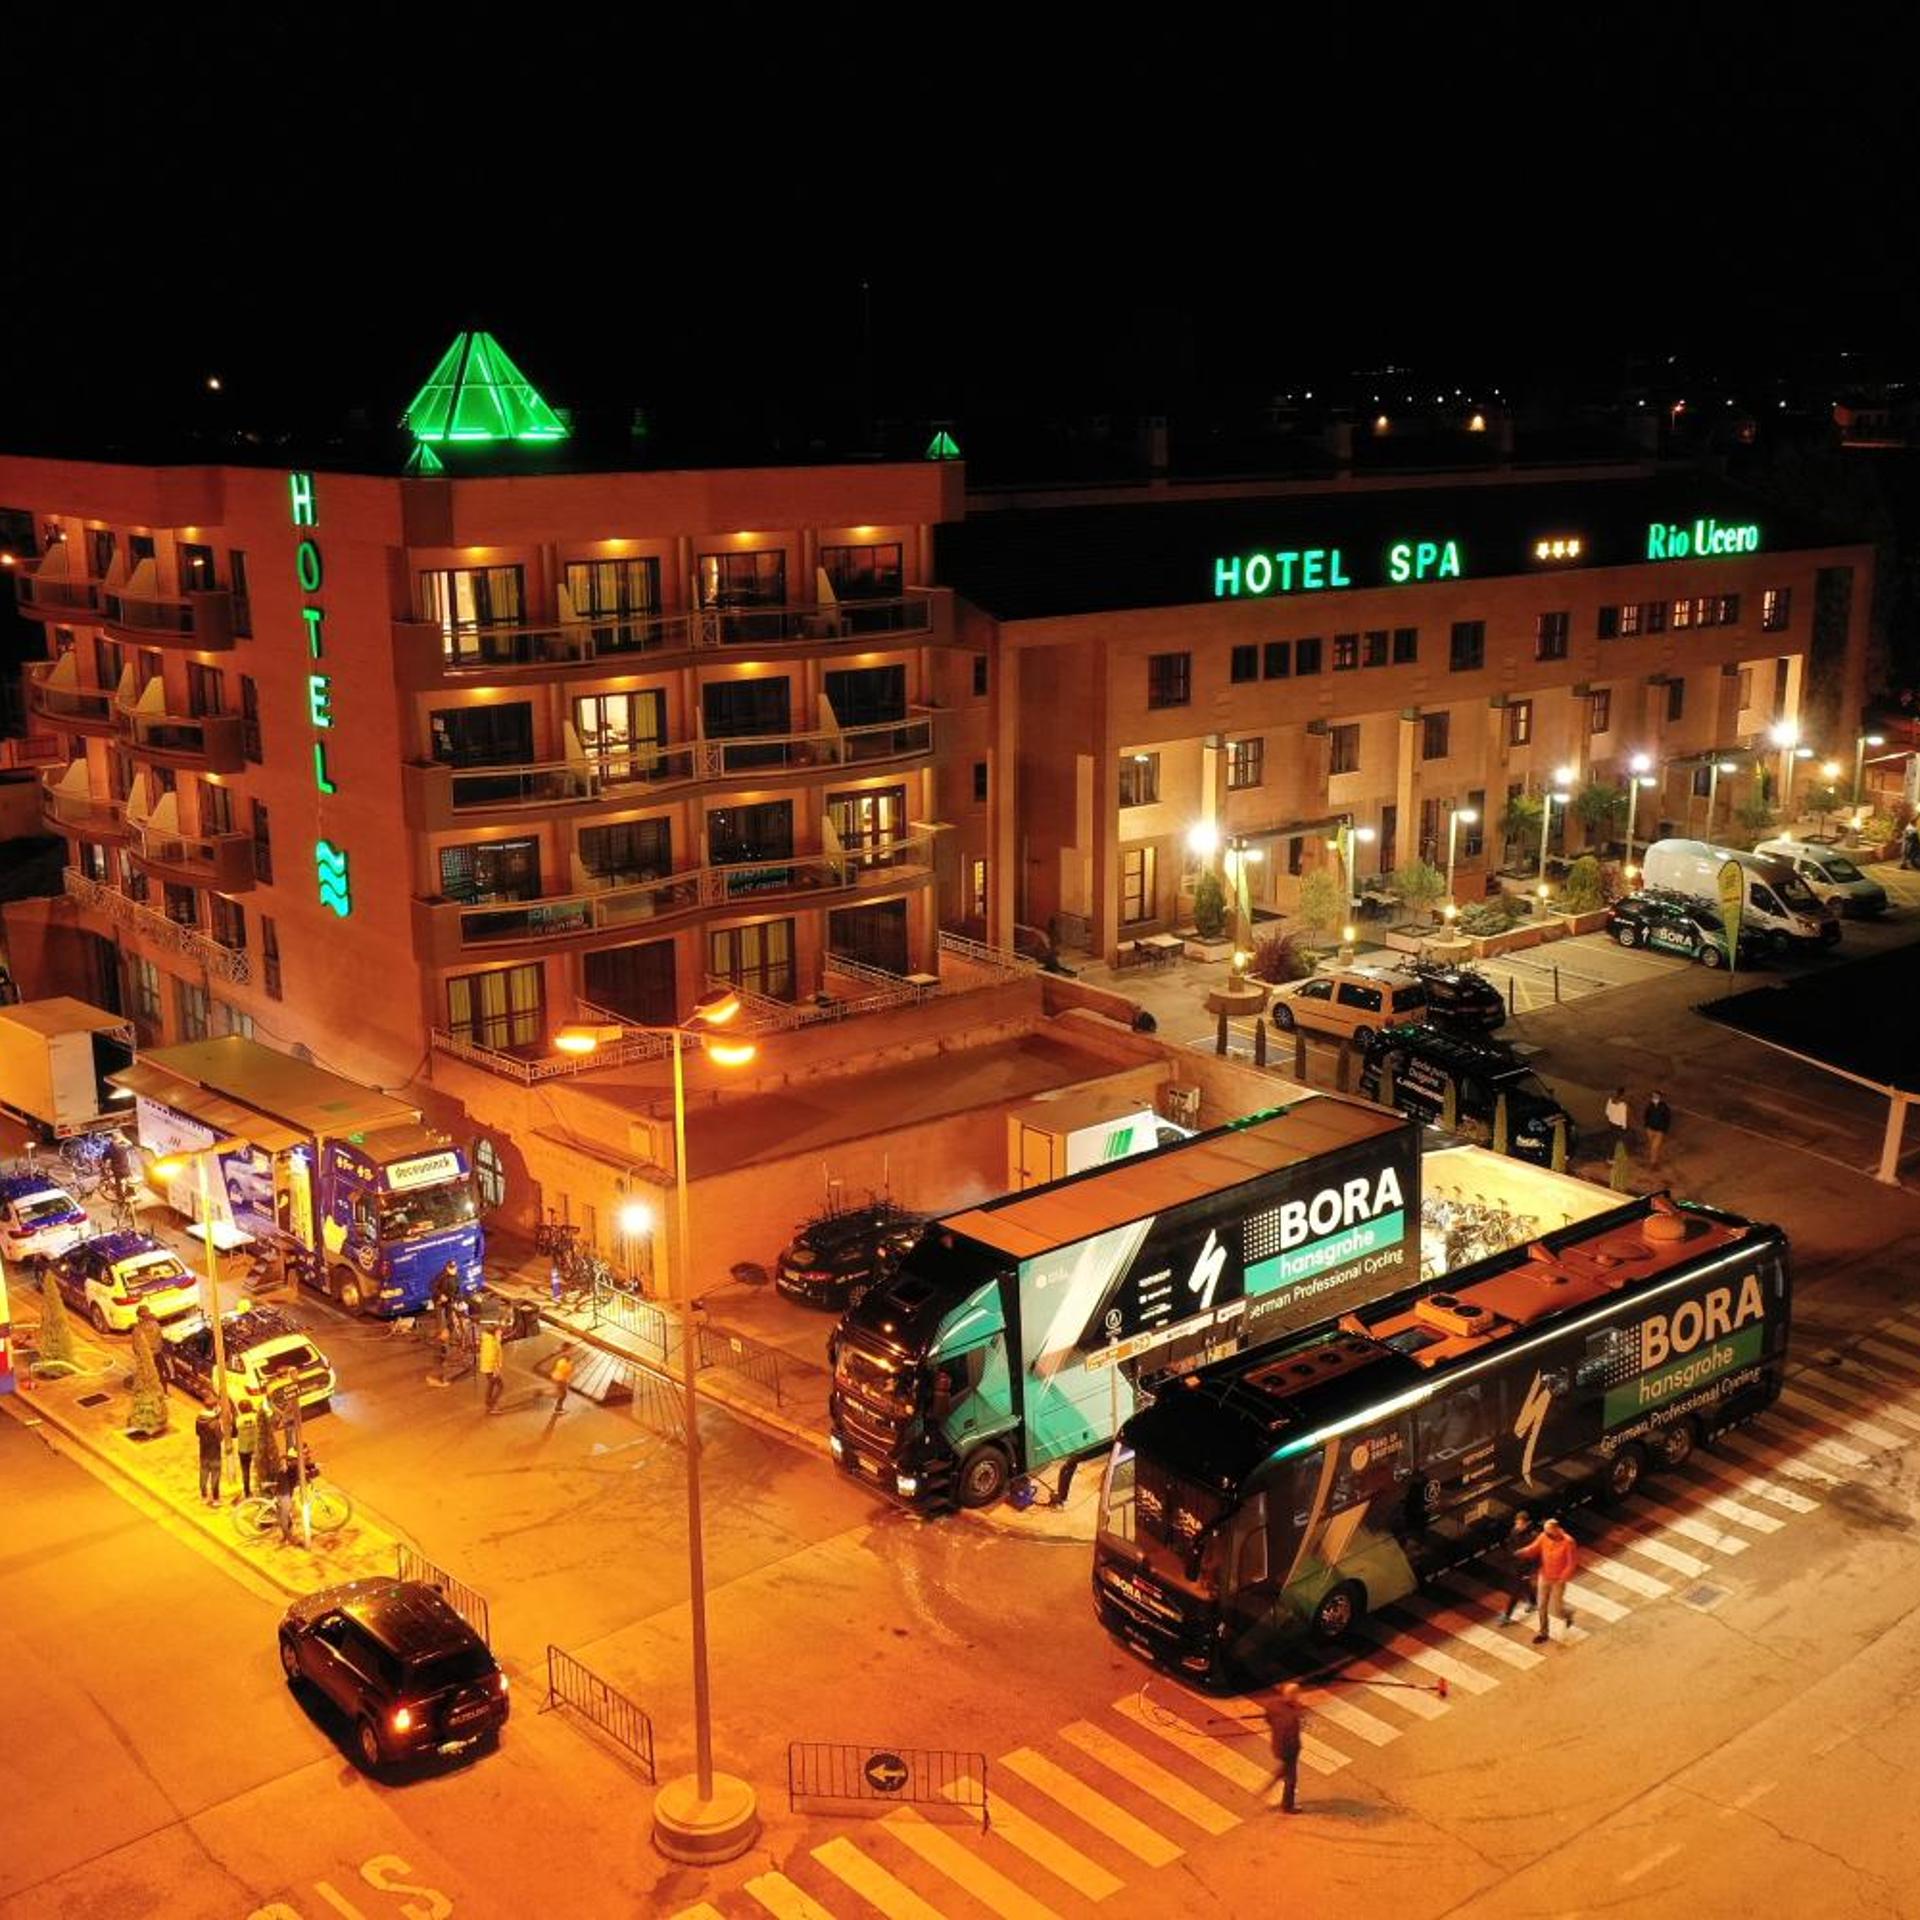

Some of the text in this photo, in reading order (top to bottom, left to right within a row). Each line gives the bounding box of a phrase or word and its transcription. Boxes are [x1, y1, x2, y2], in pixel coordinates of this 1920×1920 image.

[1695, 519, 1758, 556] Ucero
[1214, 541, 1461, 597] HOTEL SPA
[288, 474, 336, 794] HOTEL
[1659, 927, 1693, 948] BORA
[1280, 1166, 1404, 1249] BORA
[1280, 1226, 1376, 1279] hansgrohe
[1294, 1262, 1362, 1300] Professional
[1364, 1249, 1404, 1275] Cycling
[1641, 1274, 1764, 1370] BORA
[1639, 1344, 1734, 1404] hansgrohe
[1600, 1366, 1762, 1451] German Professional Cycling
